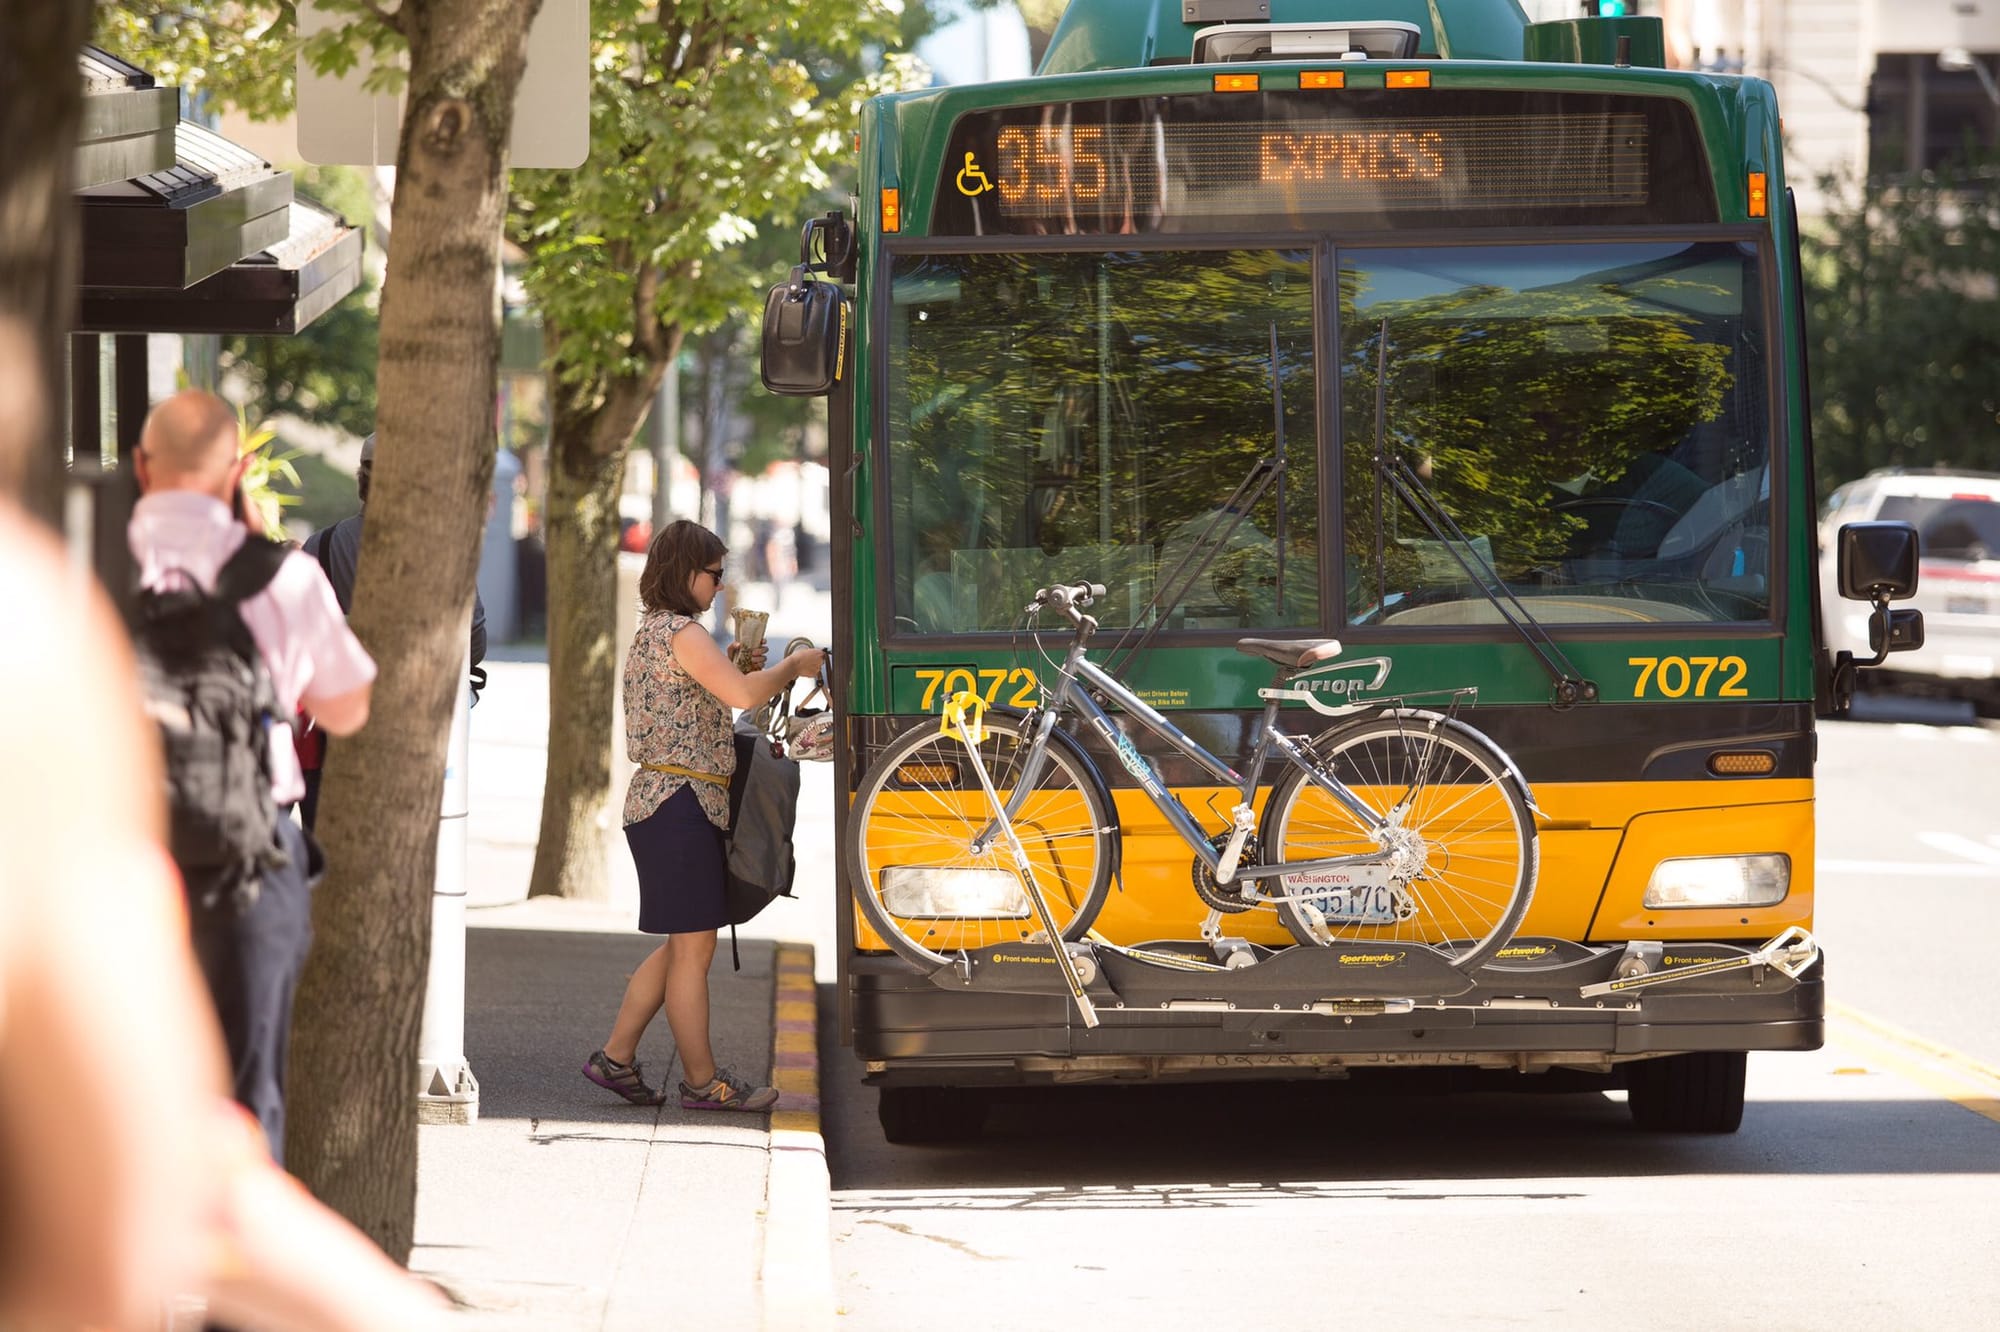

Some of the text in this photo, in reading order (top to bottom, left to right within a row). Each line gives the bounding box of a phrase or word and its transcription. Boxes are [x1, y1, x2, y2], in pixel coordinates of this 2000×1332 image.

[997, 128, 1442, 199] 355 EXPRESS
[1628, 655, 1748, 698] 7072
[915, 667, 1038, 711] 7072
[1288, 875, 1350, 884] WASHINGTON
[1496, 946, 1546, 957] portworks
[1339, 954, 1396, 964] Sportworks
[1674, 956, 1692, 964] Front
[1693, 956, 1713, 964] wheel
